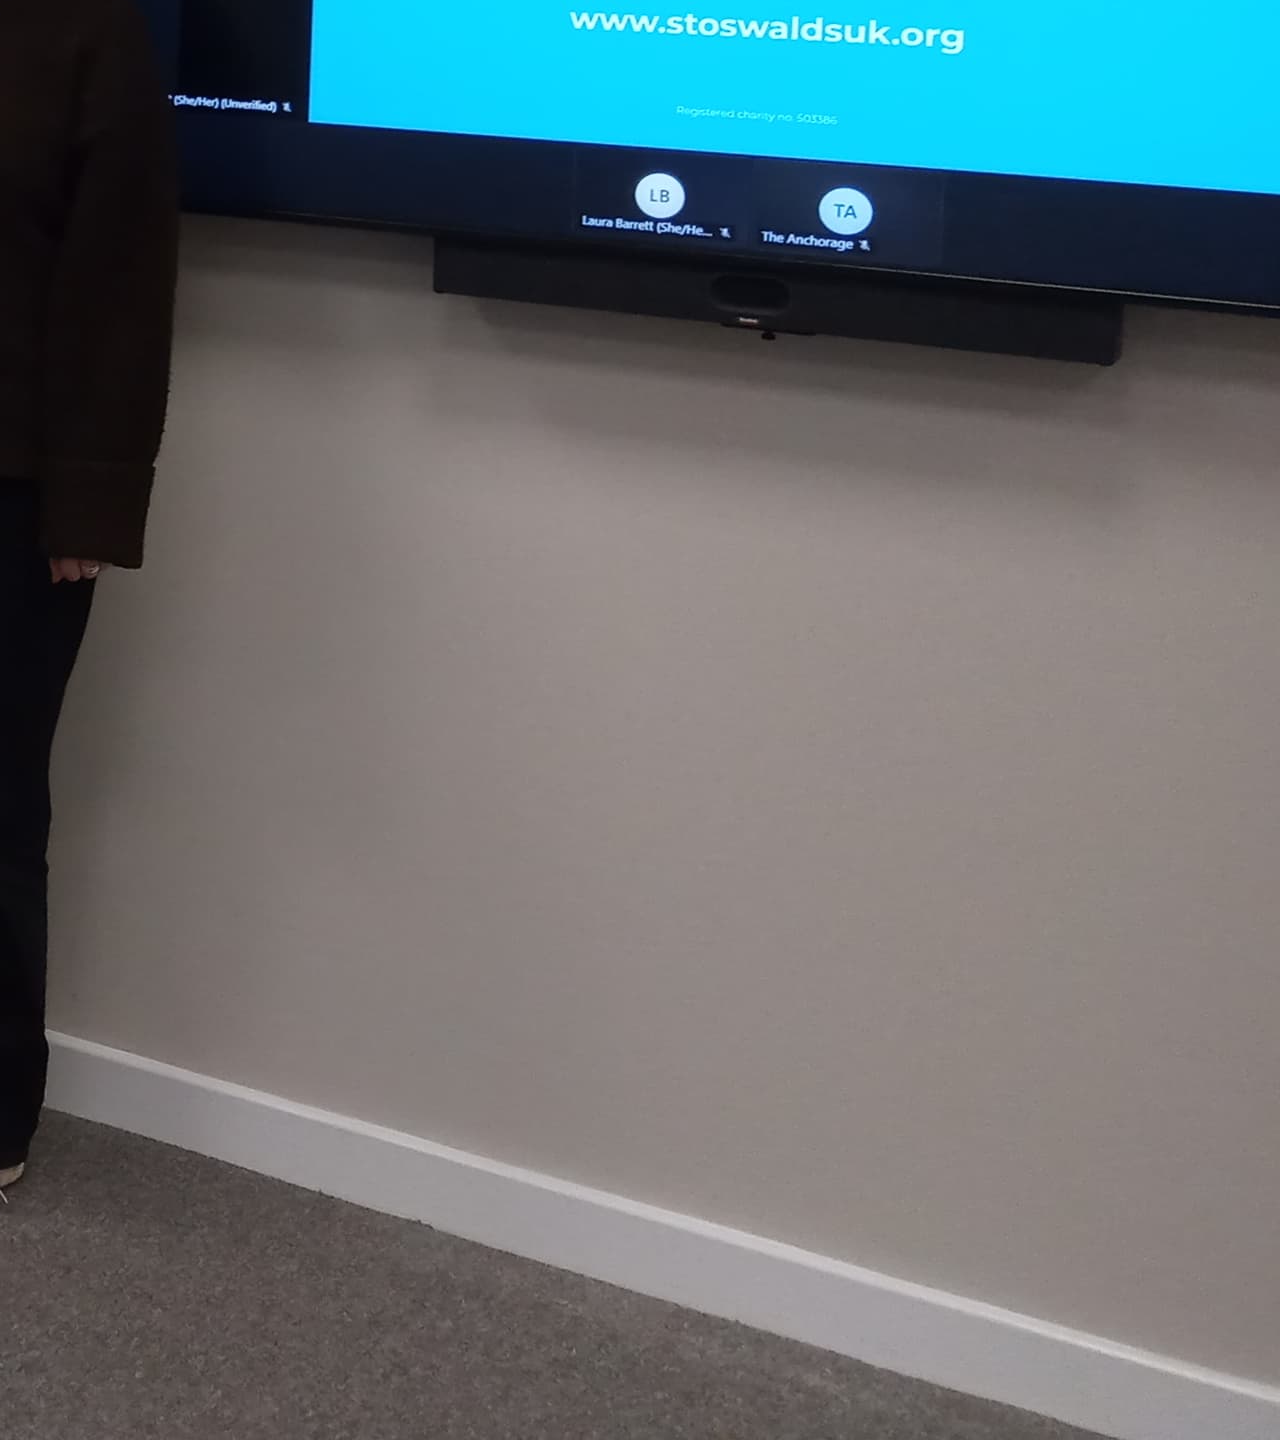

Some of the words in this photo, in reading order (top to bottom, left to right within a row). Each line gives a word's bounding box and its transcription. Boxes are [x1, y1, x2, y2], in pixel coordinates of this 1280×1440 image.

[569, 10, 966, 55] www.stoswaldsuk.org
[174, 95, 219, 109] (She/Her)
[221, 98, 277, 113] (Unverified)
[676, 105, 735, 119] Registered
[737, 109, 775, 122] charity
[650, 188, 670, 203] LB
[834, 203, 857, 219] TA
[582, 215, 614, 228] Laura
[615, 218, 654, 231] Barrett
[761, 231, 785, 243] The
[786, 234, 854, 252] Anchorage
